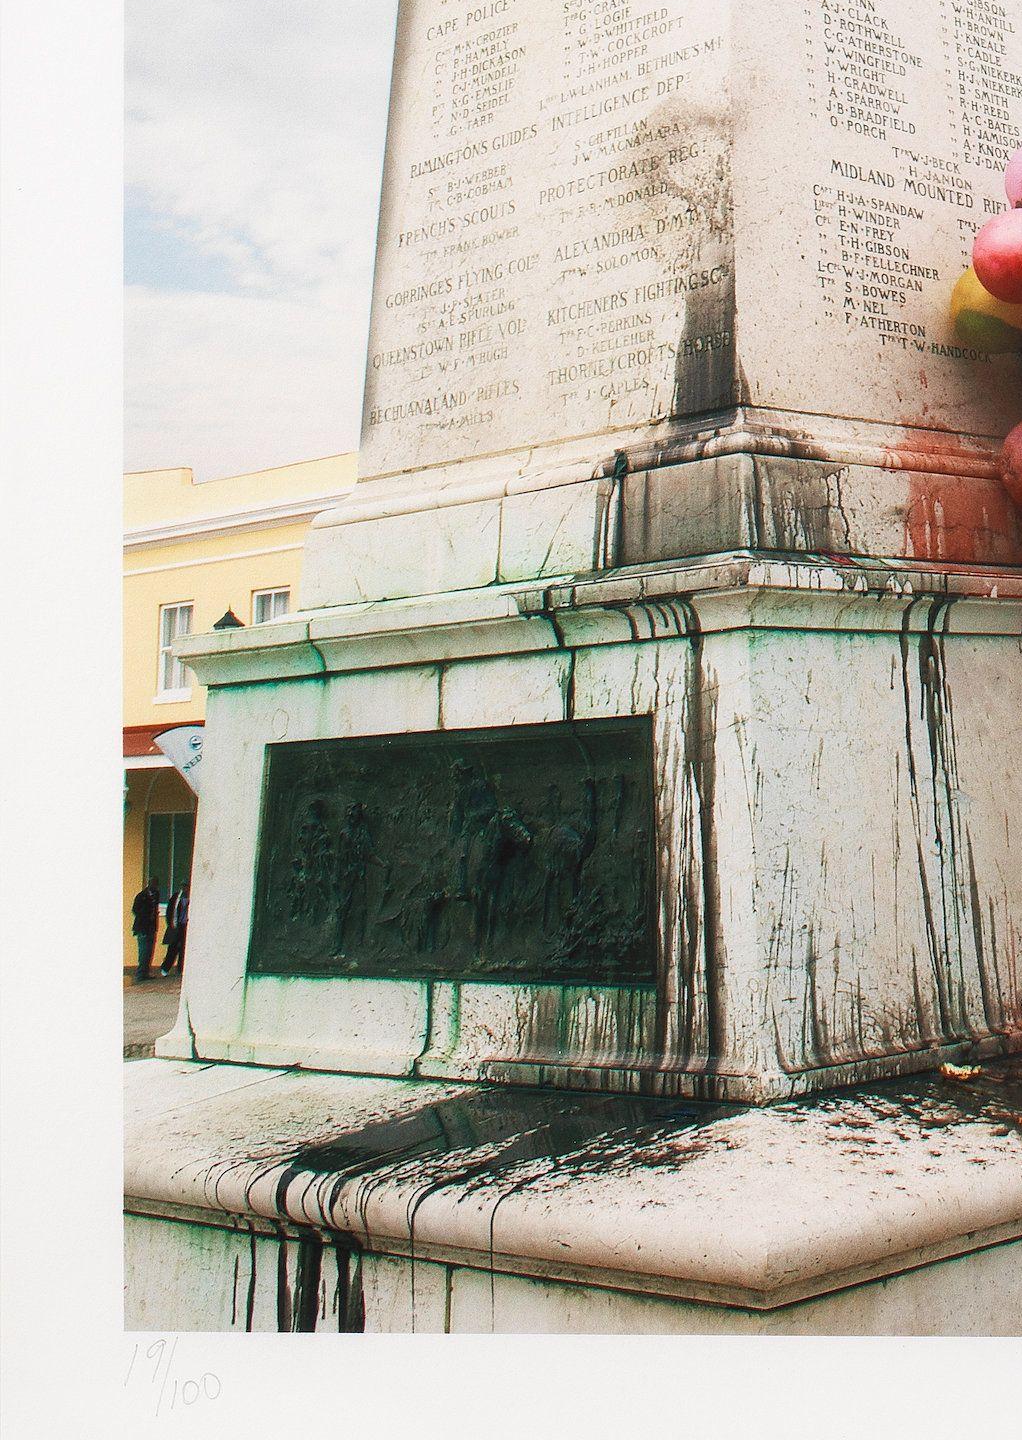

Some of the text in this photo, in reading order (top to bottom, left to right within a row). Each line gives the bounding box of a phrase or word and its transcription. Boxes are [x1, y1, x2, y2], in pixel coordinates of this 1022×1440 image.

[426, 18, 459, 41] CAPE
[550, 85, 650, 132] INTELLIGENCE
[492, 123, 538, 151] GUIDES
[539, 155, 662, 206] PROTECTORATE
[830, 158, 896, 189] MIDLAND
[903, 178, 974, 210] MOUNTED
[462, 199, 516, 228] SCOUTS
[553, 223, 645, 264] ALEXANDRIA
[458, 263, 503, 290] FLYING
[547, 289, 629, 327] KITCHENER'S
[634, 272, 700, 304] FIGHTING
[372, 336, 454, 370] QUEENSTOWN
